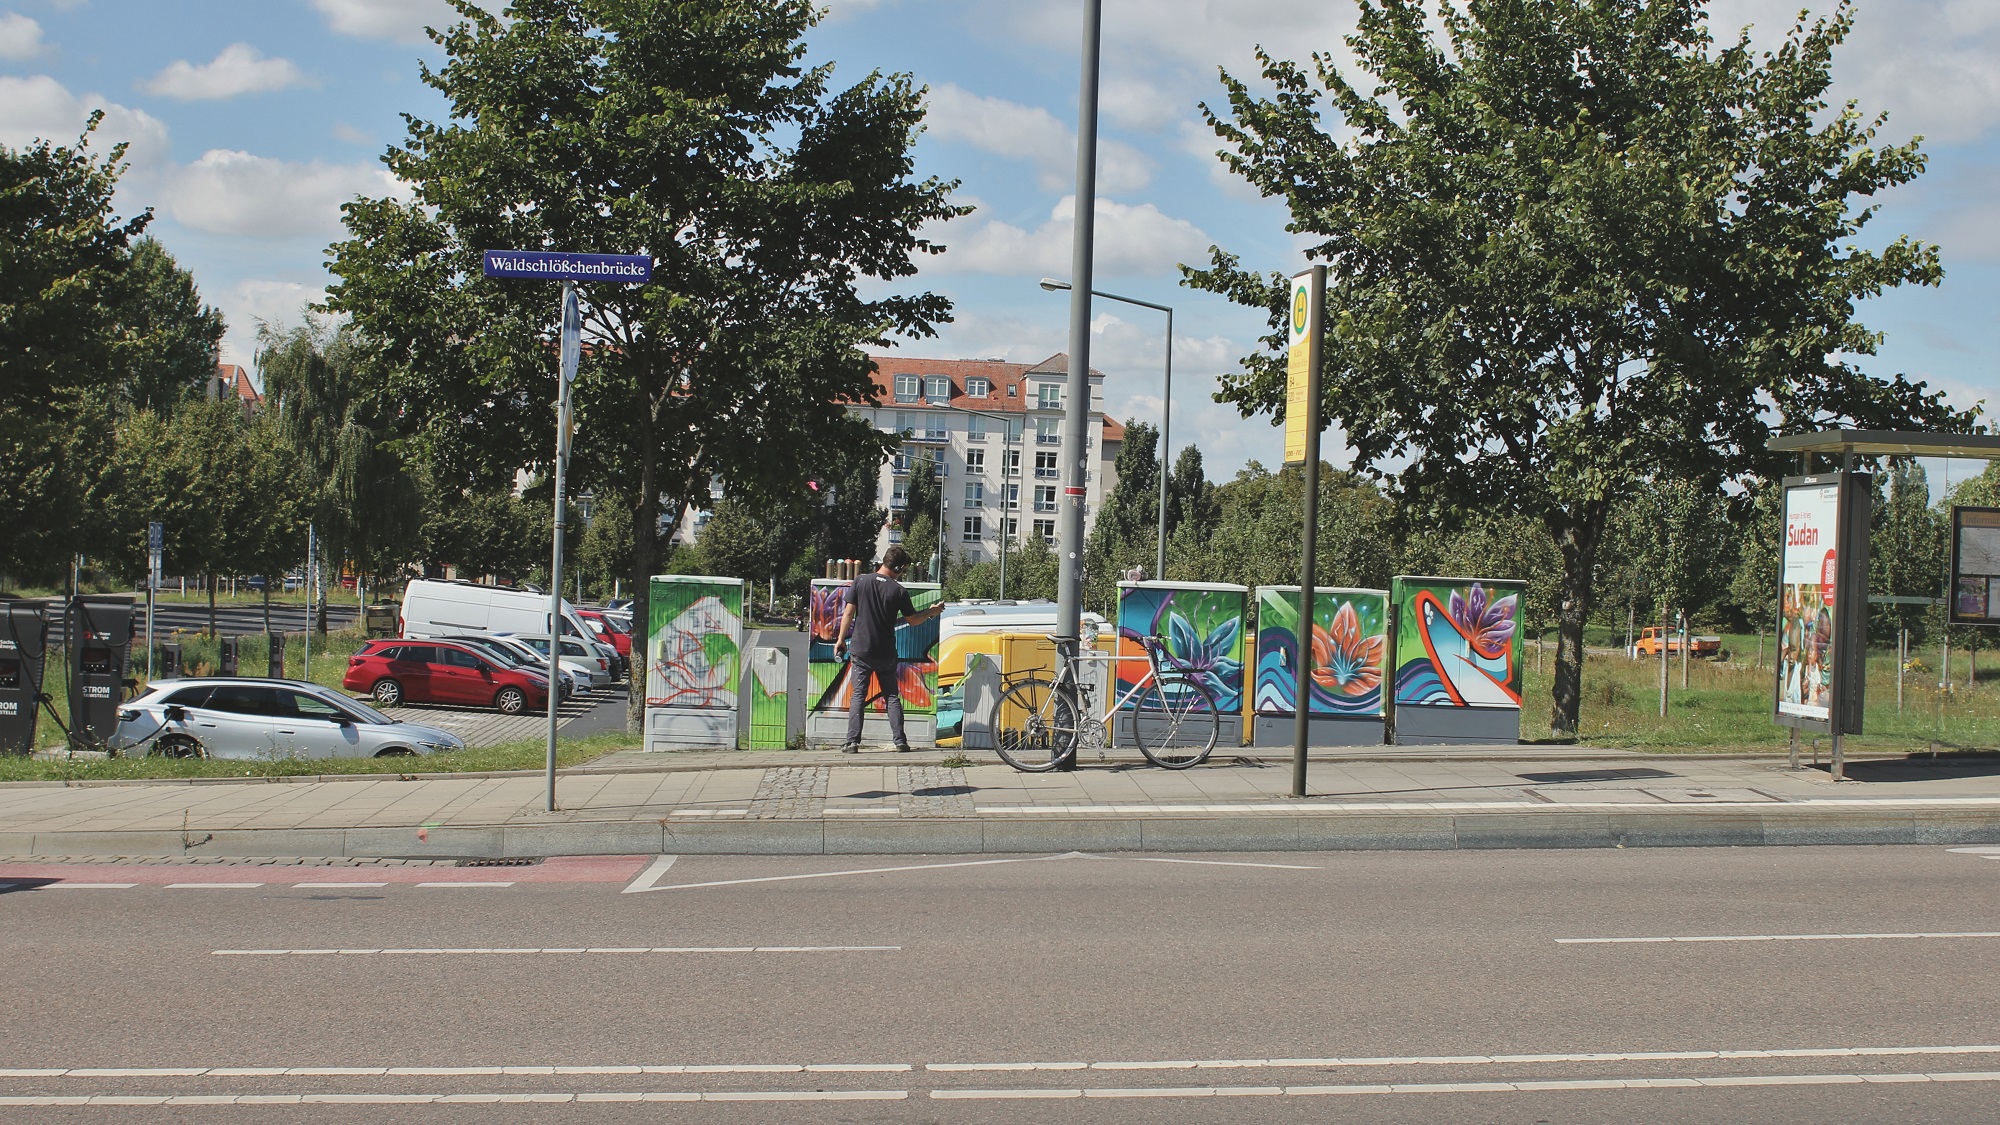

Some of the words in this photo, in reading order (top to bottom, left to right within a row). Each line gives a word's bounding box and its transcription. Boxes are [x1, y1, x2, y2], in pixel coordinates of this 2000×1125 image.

[490, 257, 646, 276] Waldschlößchenbrücke
[1788, 522, 1818, 546] Sudan
[82, 686, 110, 694] STROM
